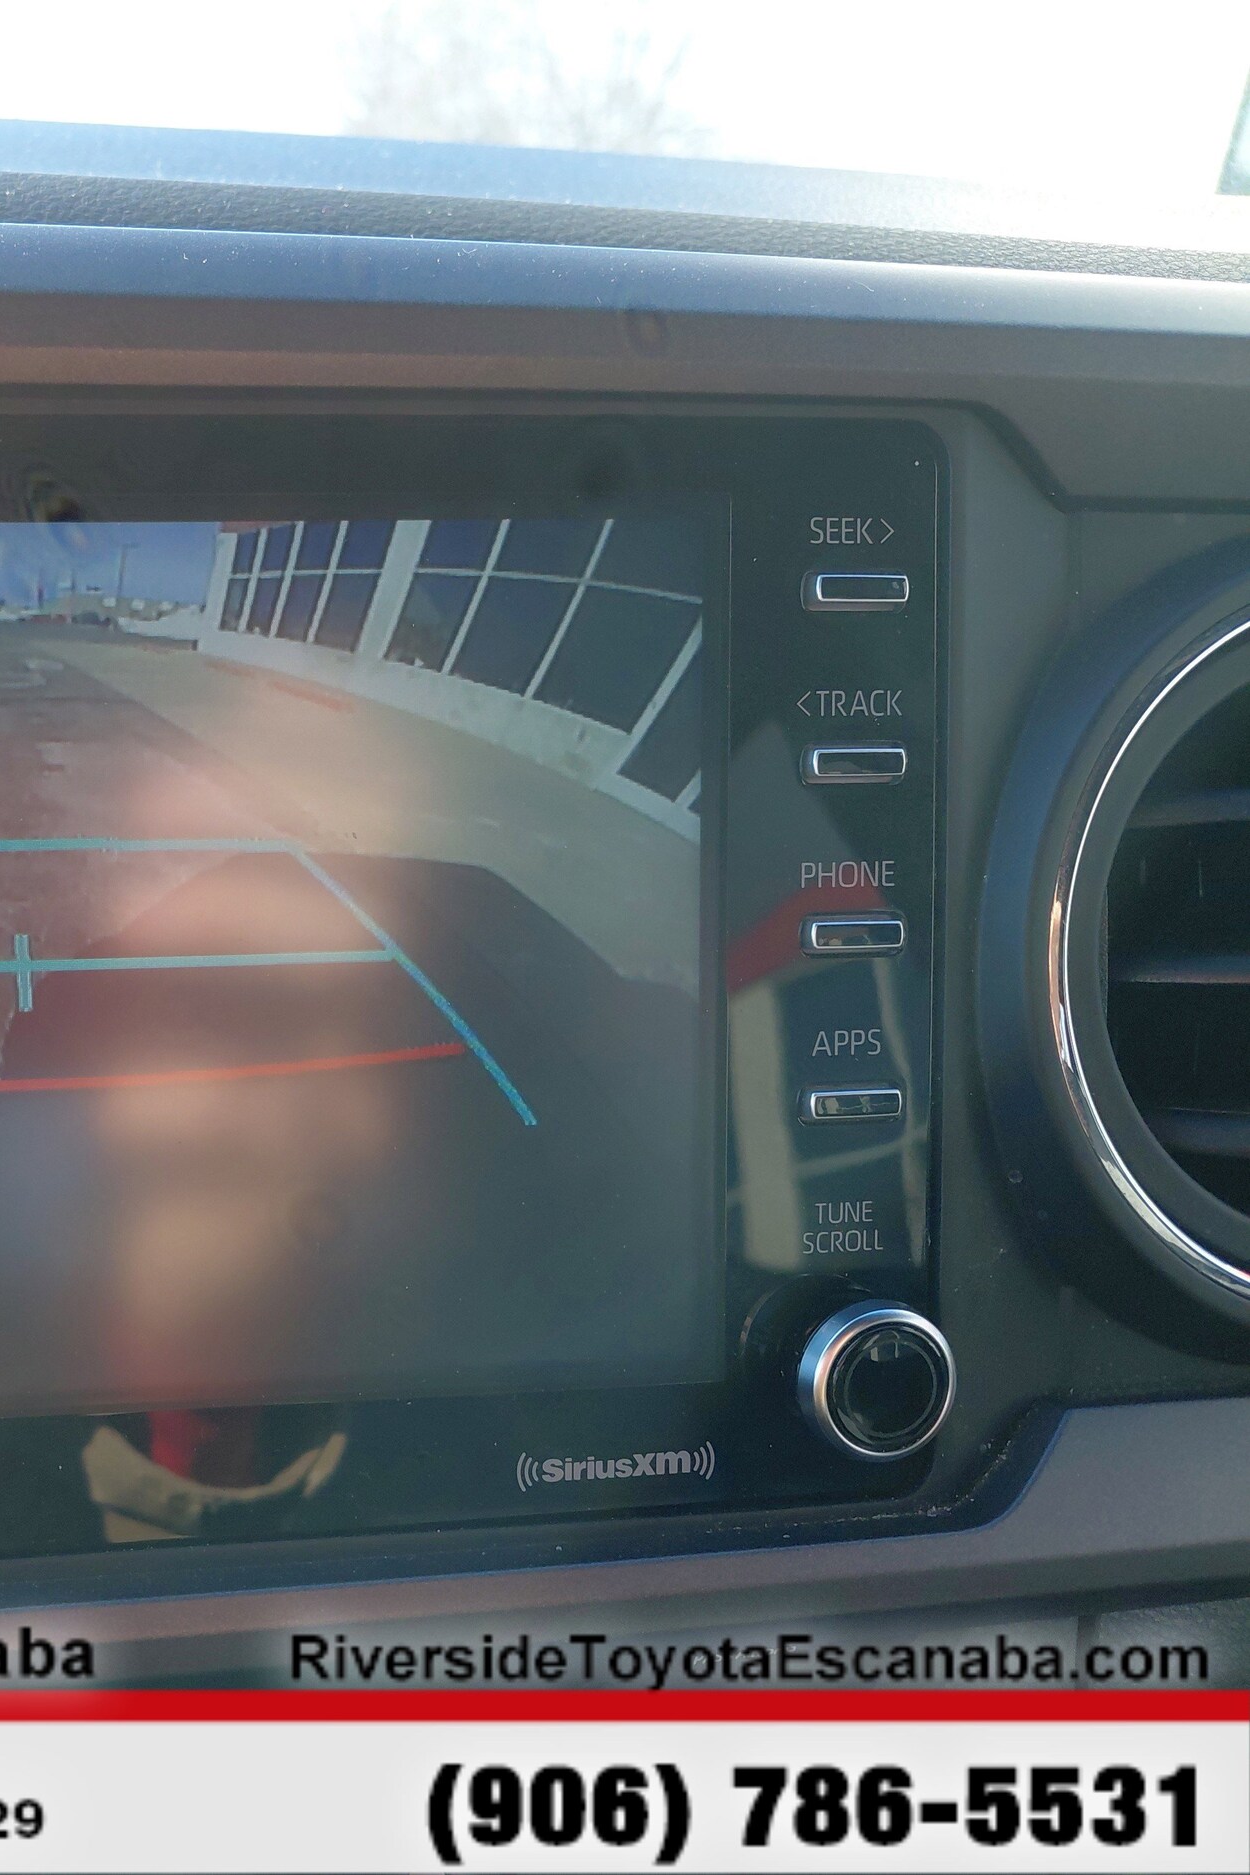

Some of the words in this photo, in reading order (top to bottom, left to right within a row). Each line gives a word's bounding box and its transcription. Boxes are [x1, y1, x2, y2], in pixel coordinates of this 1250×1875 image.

[809, 516, 874, 545] SEEK
[815, 689, 903, 717] TRACK
[800, 860, 896, 889] PHONE
[811, 1028, 883, 1057] APPS
[814, 1200, 873, 1225] TUNE
[802, 1228, 884, 1255] SCROLL
